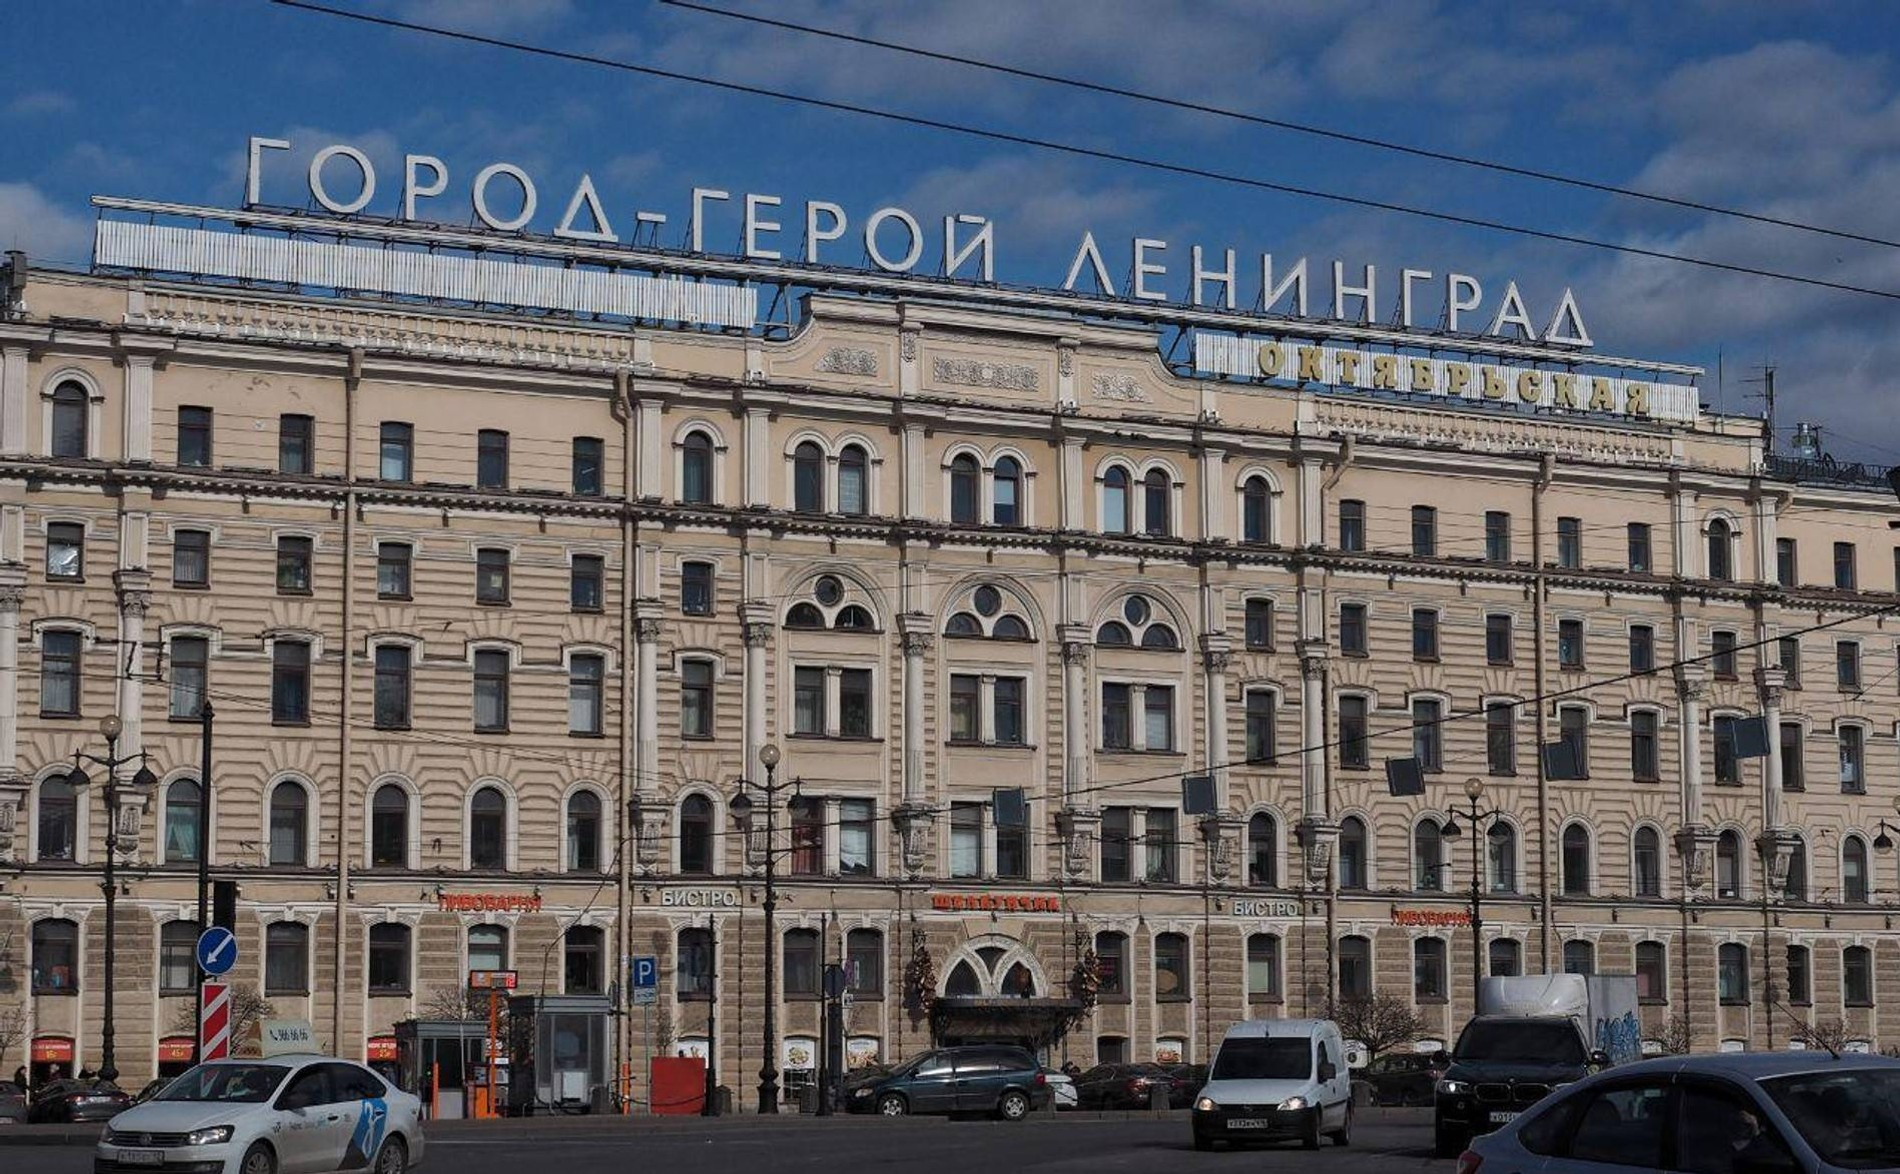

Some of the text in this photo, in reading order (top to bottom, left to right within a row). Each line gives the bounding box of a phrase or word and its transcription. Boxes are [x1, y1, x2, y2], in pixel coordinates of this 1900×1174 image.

[1064, 231, 1594, 347] ЛЕНИНГРАД
[1258, 341, 1650, 415] ОКТЯБРЬСКАЯ
[662, 890, 736, 906] БИСТРО
[1234, 901, 1298, 916] БИСТРО
